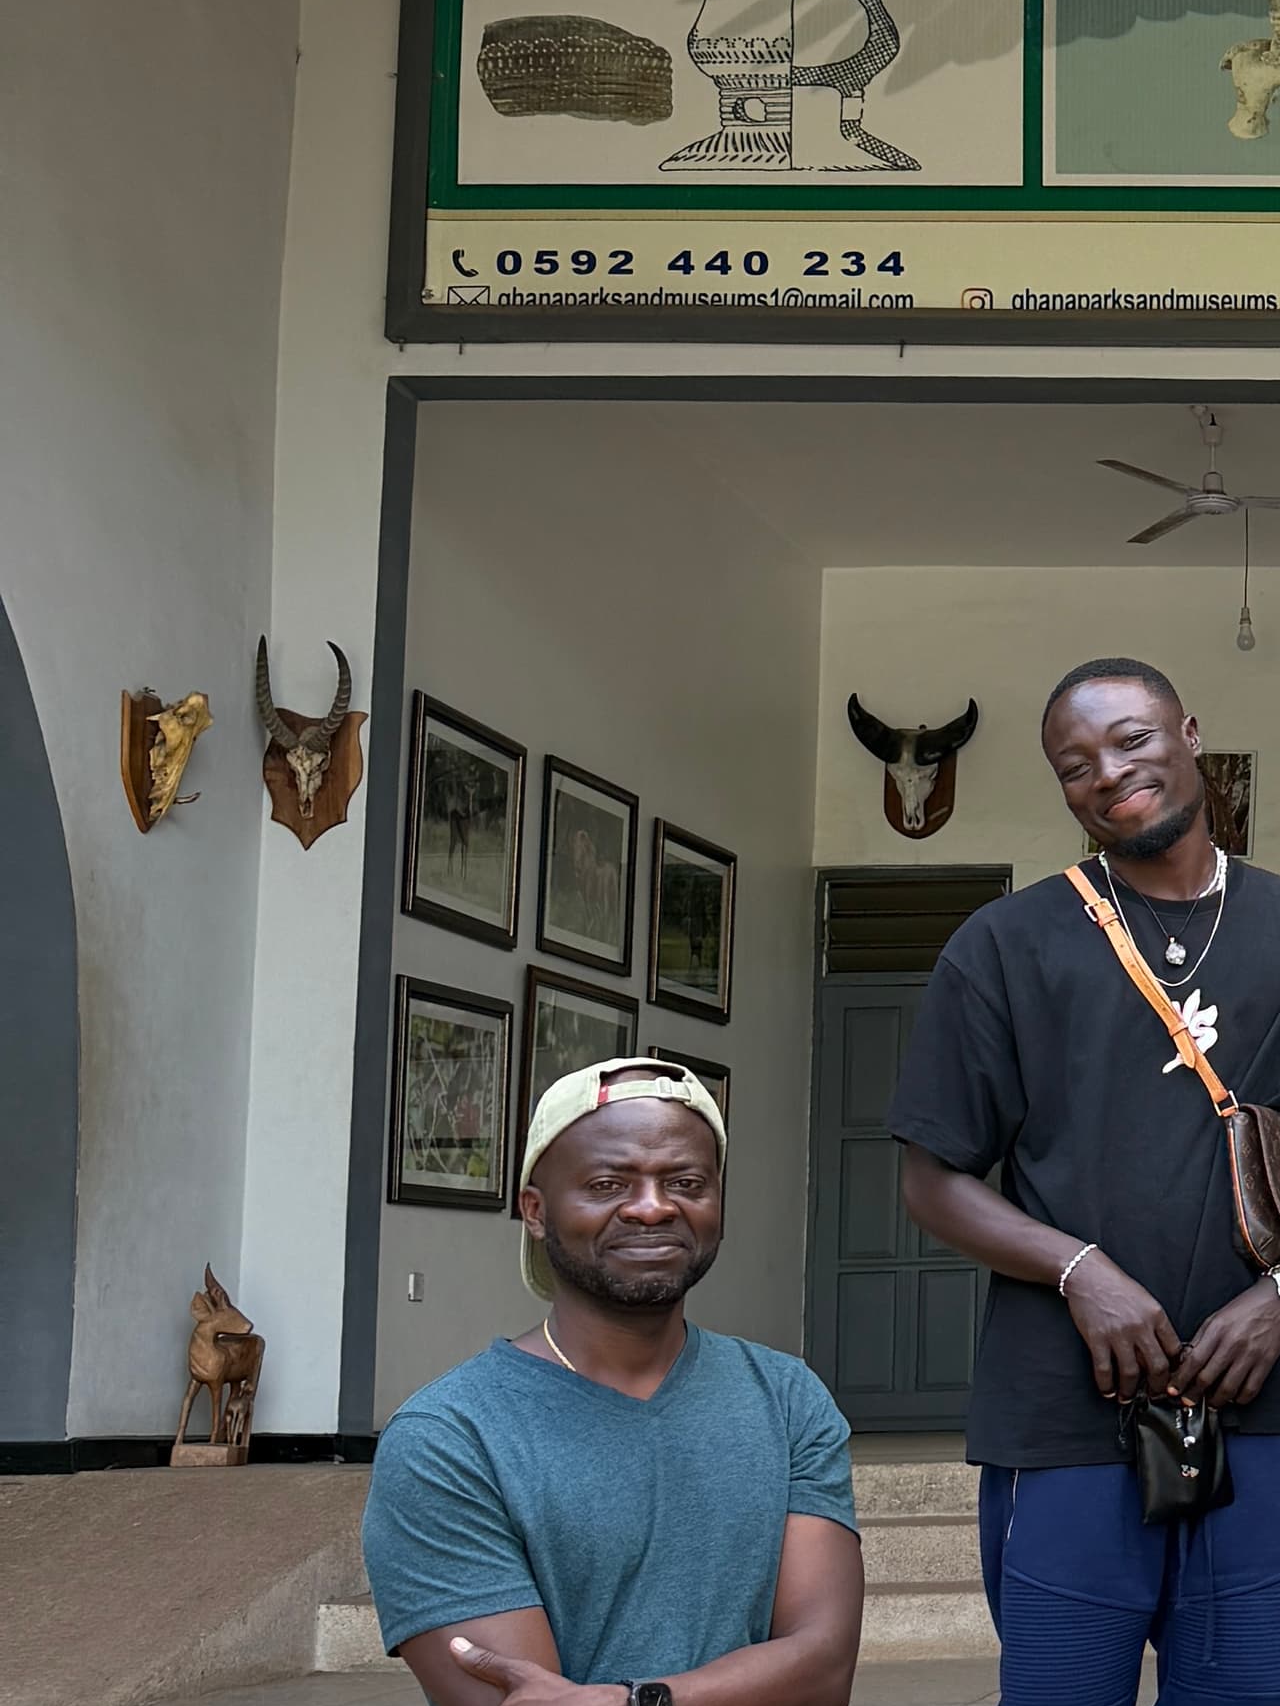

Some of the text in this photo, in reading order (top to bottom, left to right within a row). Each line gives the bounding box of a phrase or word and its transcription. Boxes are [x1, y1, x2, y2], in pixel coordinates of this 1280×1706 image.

[496, 249, 905, 277] 0592 440 234
[1011, 287, 1278, 310] ghanaparksandmuseums
